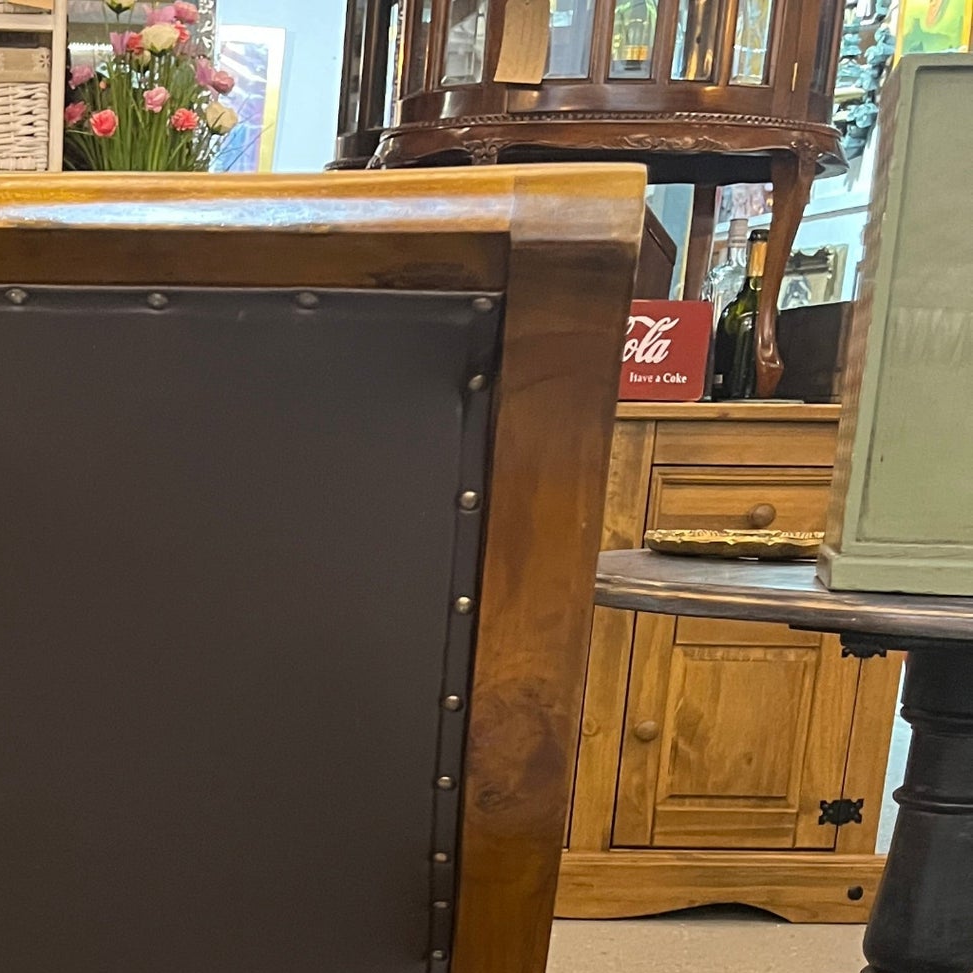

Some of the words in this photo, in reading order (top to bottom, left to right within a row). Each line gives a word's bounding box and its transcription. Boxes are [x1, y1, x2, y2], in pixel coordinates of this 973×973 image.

[629, 371, 654, 383] Have
[655, 375, 661, 383] a
[663, 372, 687, 384] Coke
